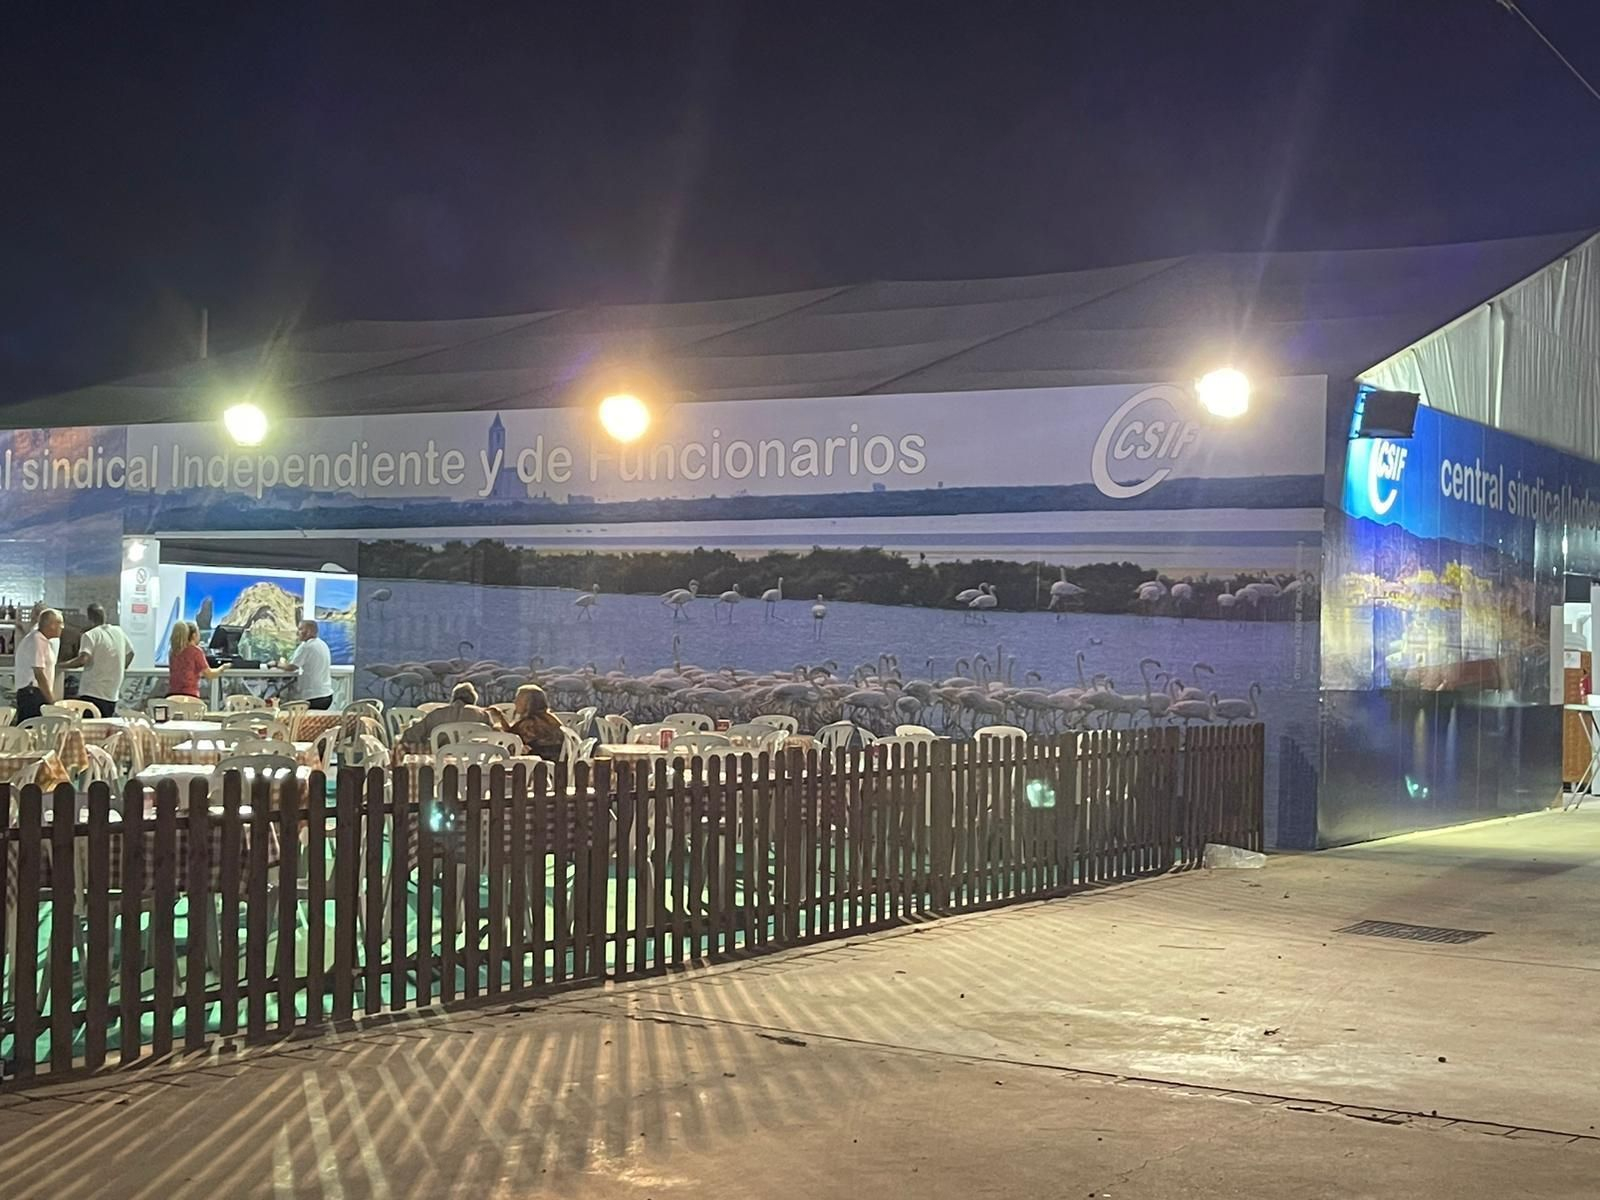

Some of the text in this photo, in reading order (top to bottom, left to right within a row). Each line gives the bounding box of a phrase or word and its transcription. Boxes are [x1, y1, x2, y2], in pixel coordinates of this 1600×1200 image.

[22, 445, 158, 491] sindical
[172, 439, 466, 500] Independiente
[477, 447, 503, 497] y
[516, 434, 573, 484] de
[590, 423, 927, 483] Funcionarios
[1377, 441, 1408, 481] CSIF
[1440, 457, 1504, 511] central
[1507, 470, 1566, 526] sindical
